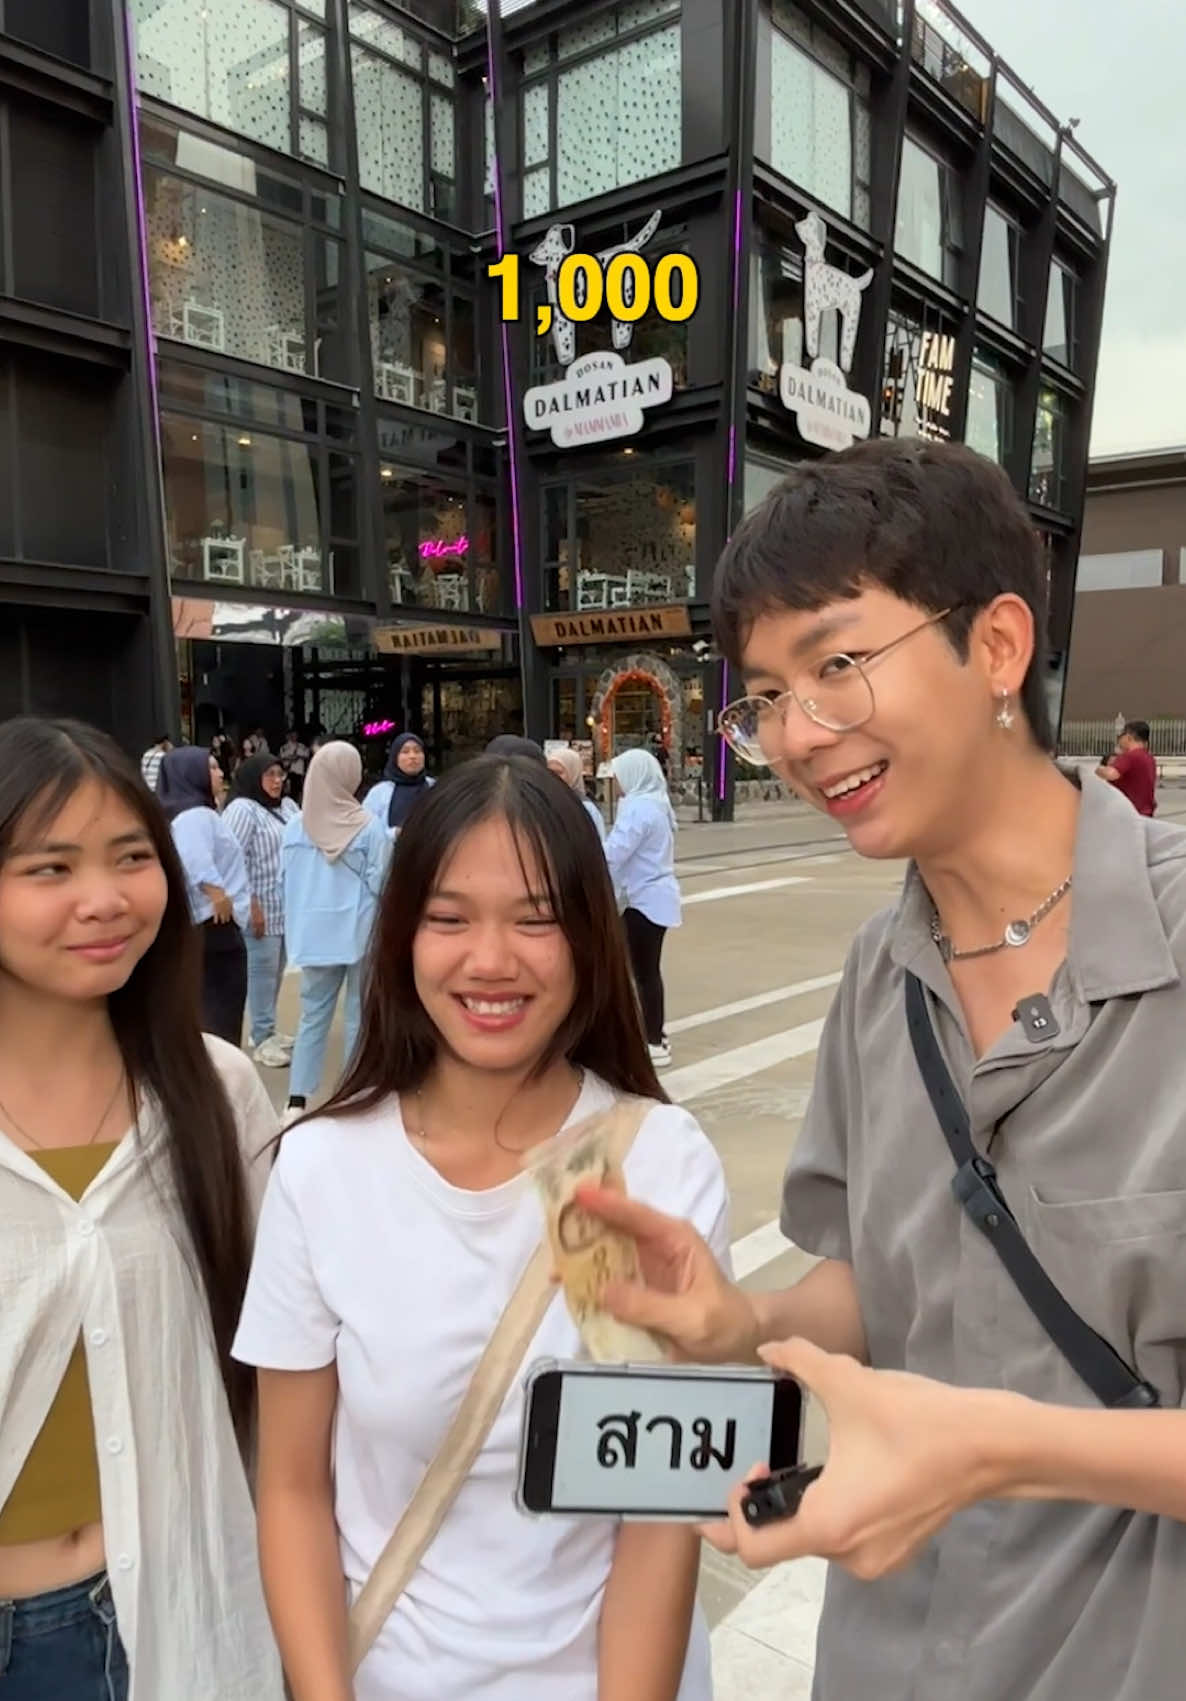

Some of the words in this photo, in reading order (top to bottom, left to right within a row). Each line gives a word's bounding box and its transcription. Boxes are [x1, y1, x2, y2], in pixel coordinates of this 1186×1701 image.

[534, 372, 661, 418] DALMATIAN
[787, 375, 865, 425] DALMATIAN
[916, 366, 954, 417] TIME
[554, 612, 664, 638] DALMATIAN
[595, 1409, 738, 1472] สาม
